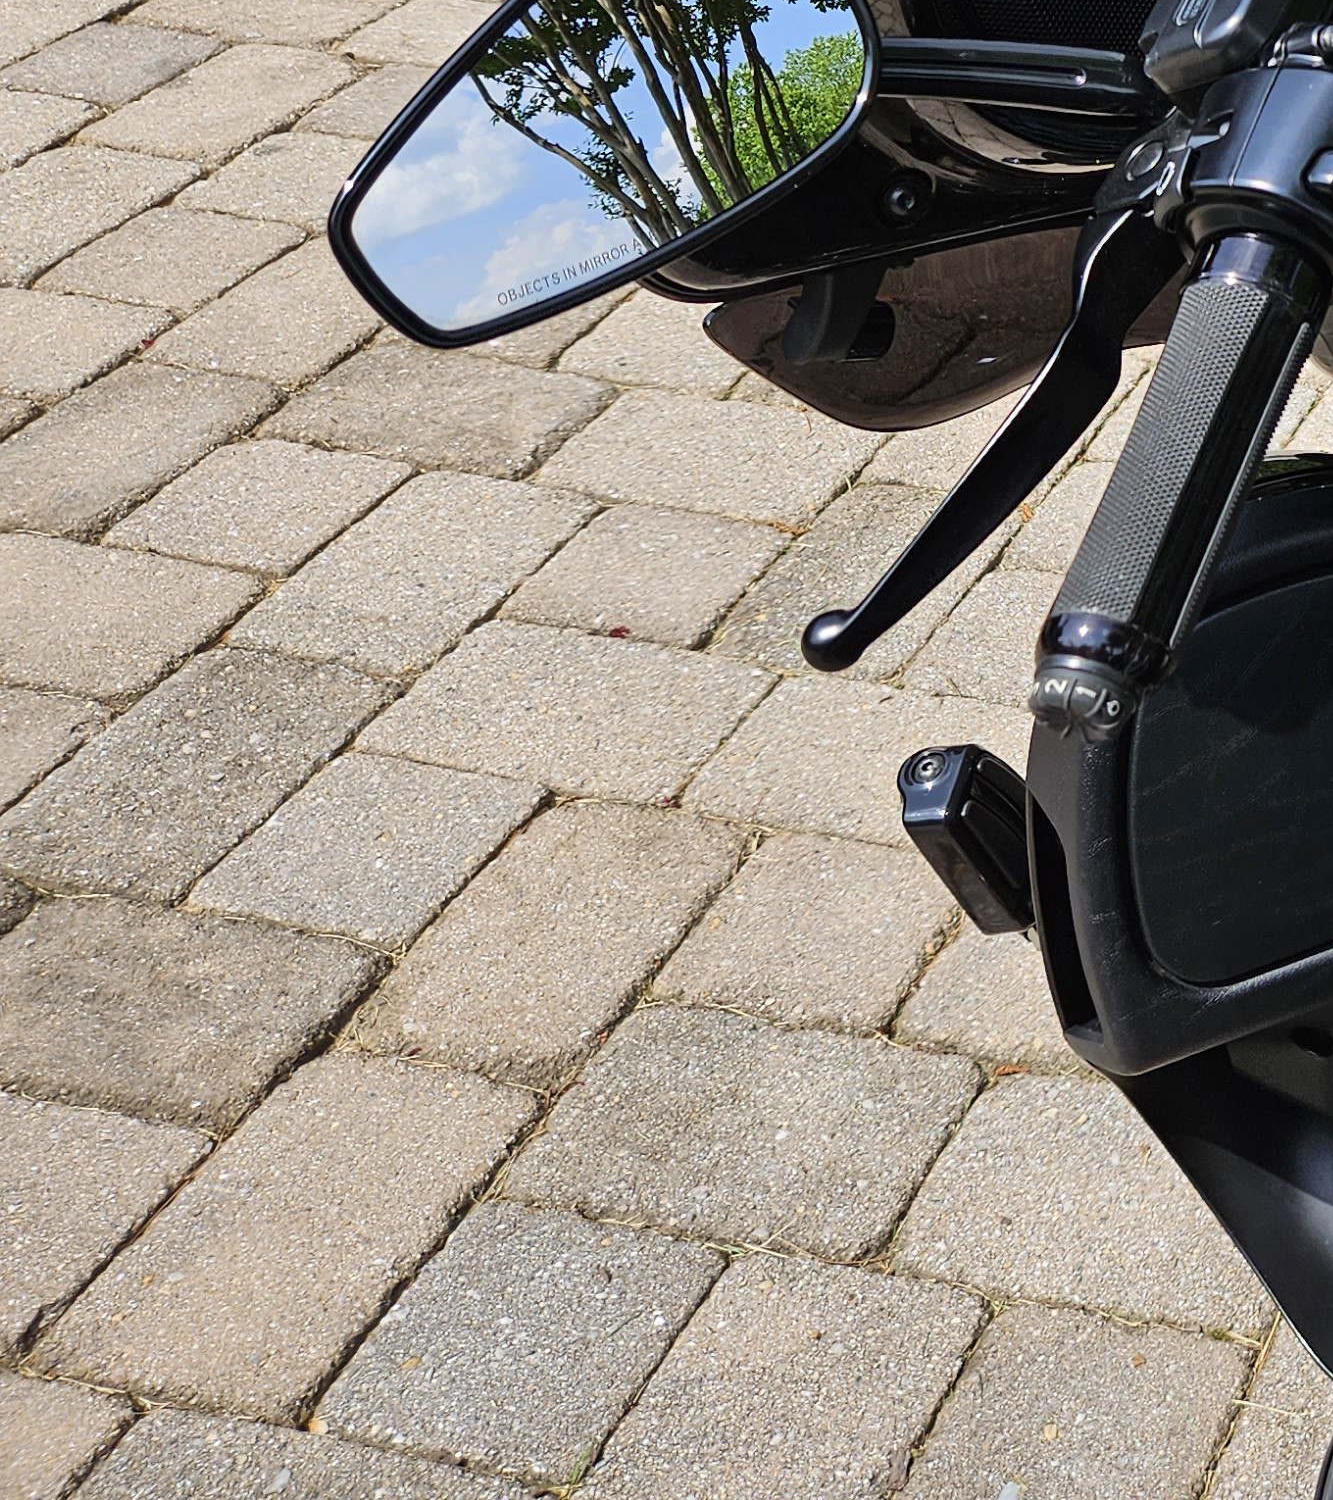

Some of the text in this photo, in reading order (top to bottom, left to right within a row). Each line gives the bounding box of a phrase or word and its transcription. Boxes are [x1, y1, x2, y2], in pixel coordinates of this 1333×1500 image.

[497, 272, 561, 306] OBJECTS
[563, 266, 577, 282] IN
[578, 243, 630, 274] MIRROR
